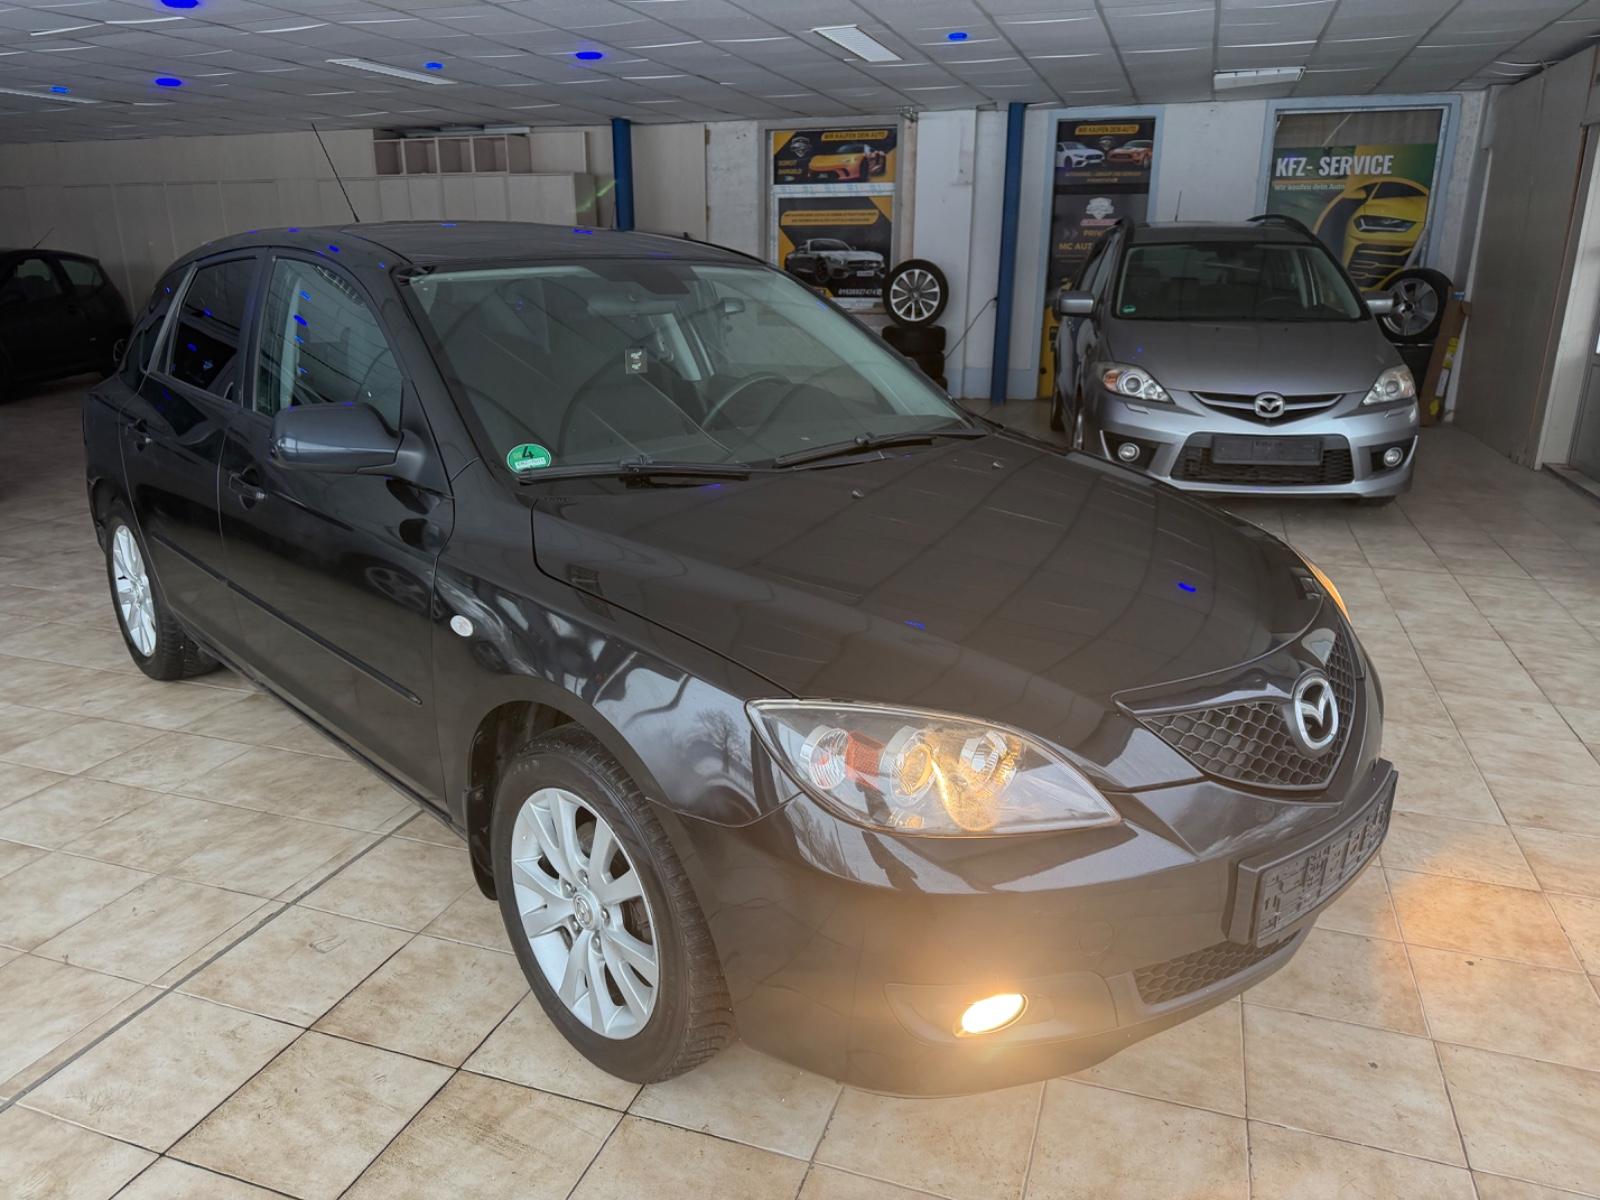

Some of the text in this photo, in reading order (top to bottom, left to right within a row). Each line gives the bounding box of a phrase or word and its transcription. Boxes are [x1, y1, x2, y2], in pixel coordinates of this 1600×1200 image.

[1275, 155, 1394, 177] KFZ- SERVICE
[1074, 242, 1093, 250] AUT
[522, 446, 535, 458] 4
